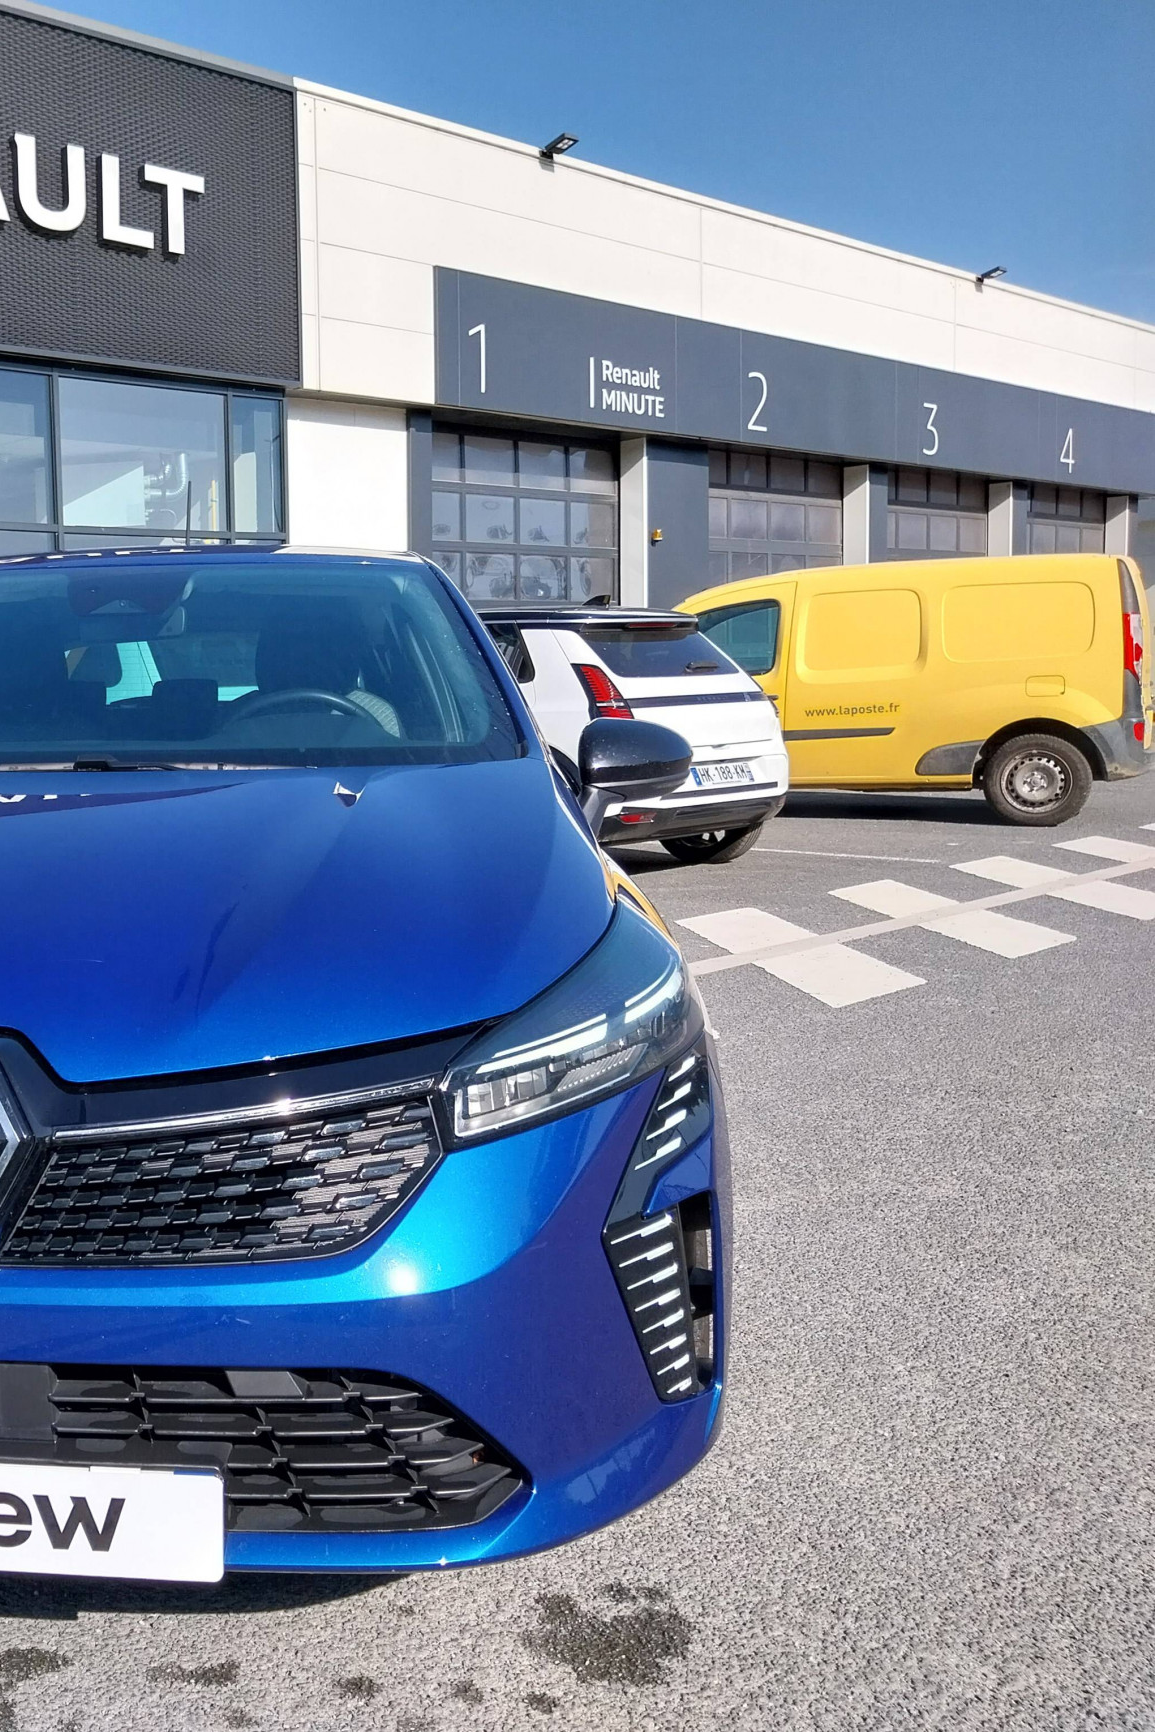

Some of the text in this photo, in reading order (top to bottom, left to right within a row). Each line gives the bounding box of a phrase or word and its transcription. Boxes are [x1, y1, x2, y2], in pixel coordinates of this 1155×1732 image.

[468, 323, 486, 393] 1
[601, 359, 660, 390] Renault
[601, 388, 665, 418] MINUTE
[747, 371, 768, 432] 2
[922, 402, 939, 456] 3
[1059, 427, 1076, 474] 4
[804, 702, 900, 717] www.laposte.fr
